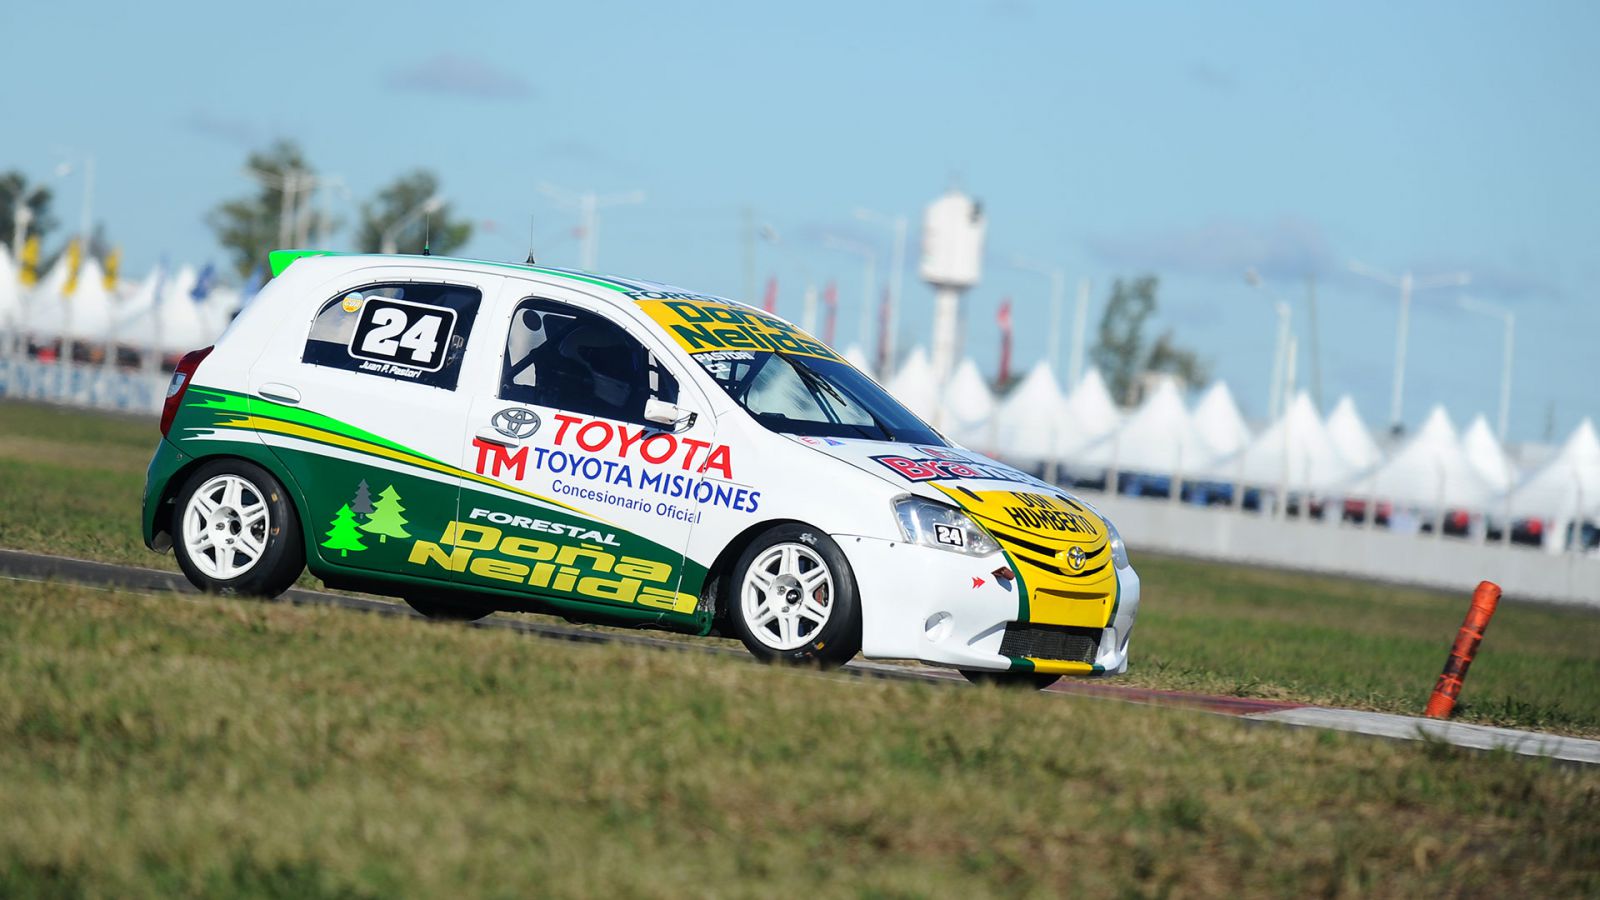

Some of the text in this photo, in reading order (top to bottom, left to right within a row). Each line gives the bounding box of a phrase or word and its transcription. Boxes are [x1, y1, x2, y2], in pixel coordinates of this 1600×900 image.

[361, 307, 443, 363] 24
[669, 323, 839, 361] Nelida
[359, 360, 382, 372] Juan
[389, 366, 422, 378] Pastori
[472, 438, 529, 481] TM
[553, 414, 733, 480] TOYOTA
[535, 447, 761, 513] TOYOTA MISIONES
[552, 479, 702, 525] Concesionario Oficial
[469, 507, 621, 547] FORESTAL
[937, 526, 962, 545] 24
[1003, 506, 1097, 535] HUMBERTO
[440, 520, 672, 584] Doña
[408, 539, 698, 615] Nelida
